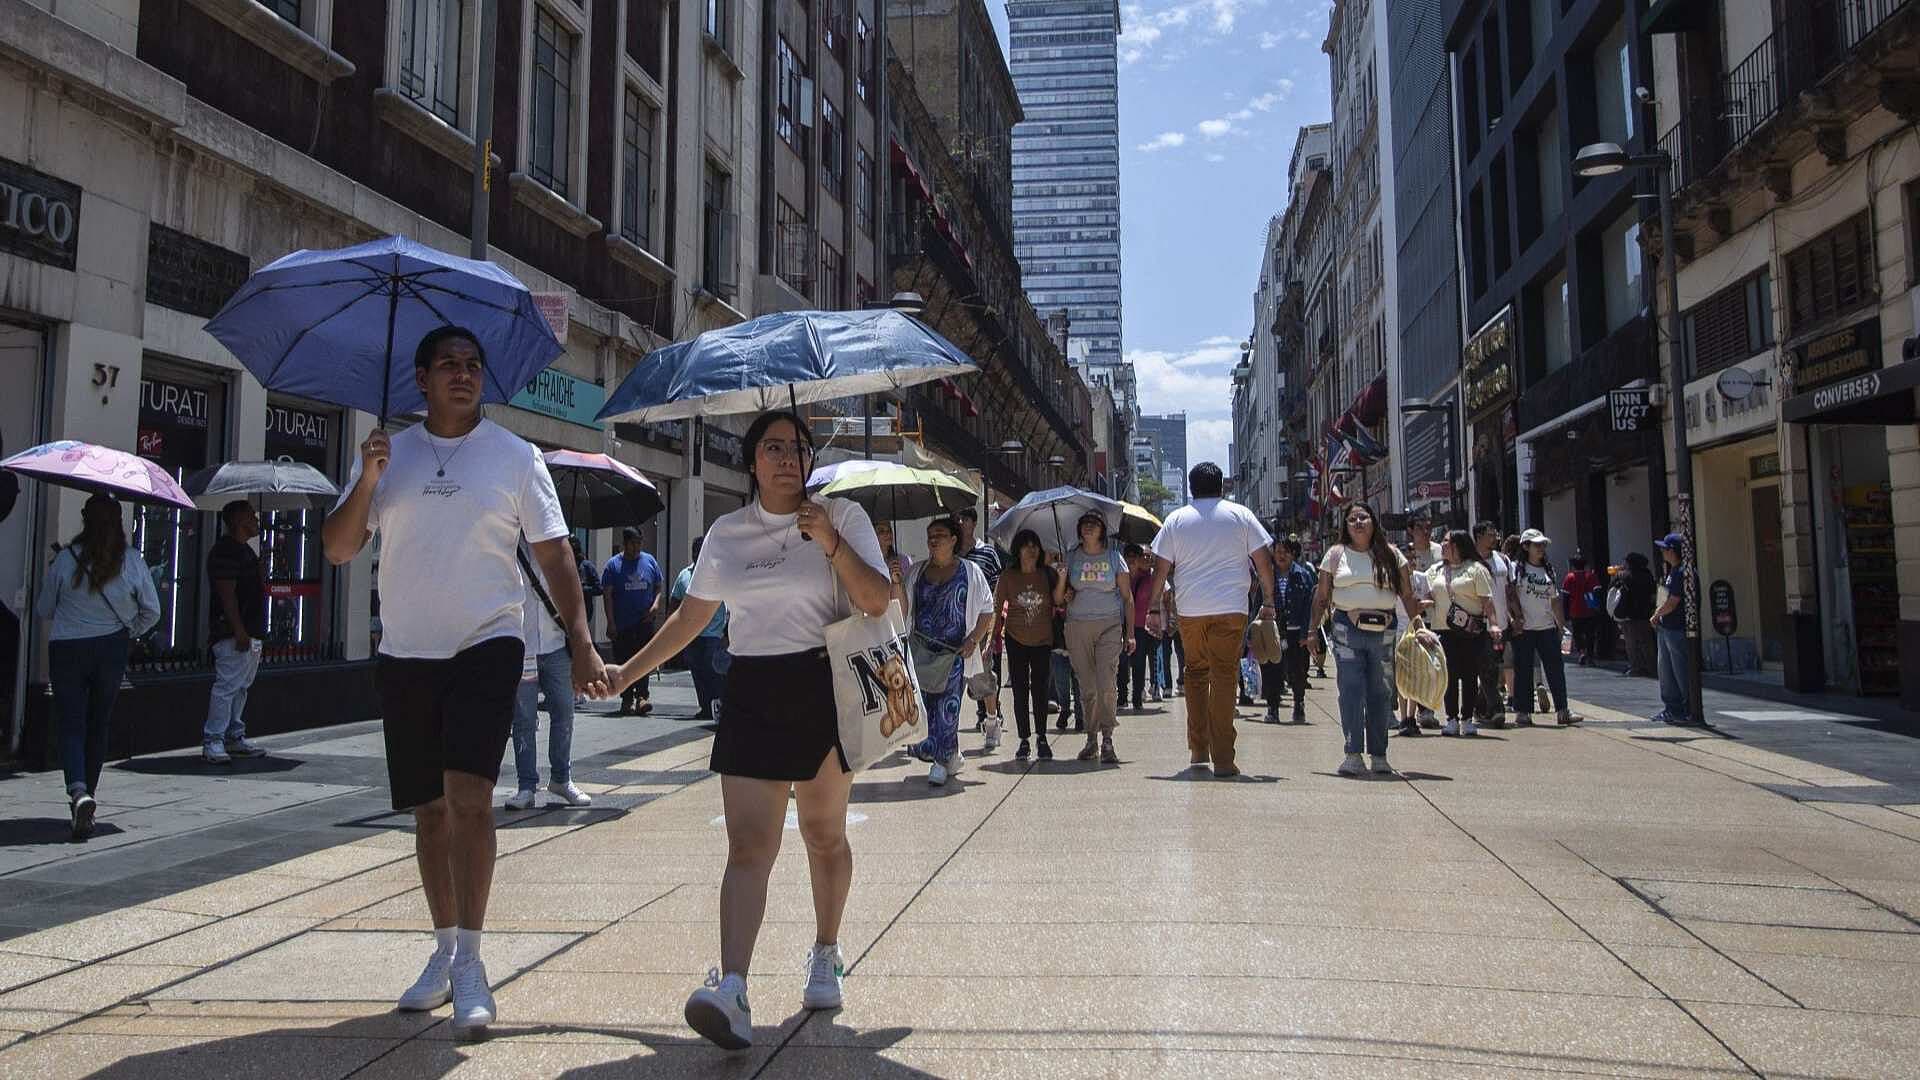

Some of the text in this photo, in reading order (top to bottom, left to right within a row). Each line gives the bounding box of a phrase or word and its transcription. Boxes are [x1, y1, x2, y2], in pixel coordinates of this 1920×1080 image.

[0, 182, 73, 243] ICO
[139, 380, 208, 419] TURATI
[1614, 393, 1641, 406] INN
[1813, 377, 1869, 409] CONVERSE
[275, 408, 328, 440] TURATI
[1615, 405, 1650, 418] VICT
[1616, 418, 1638, 431] US
